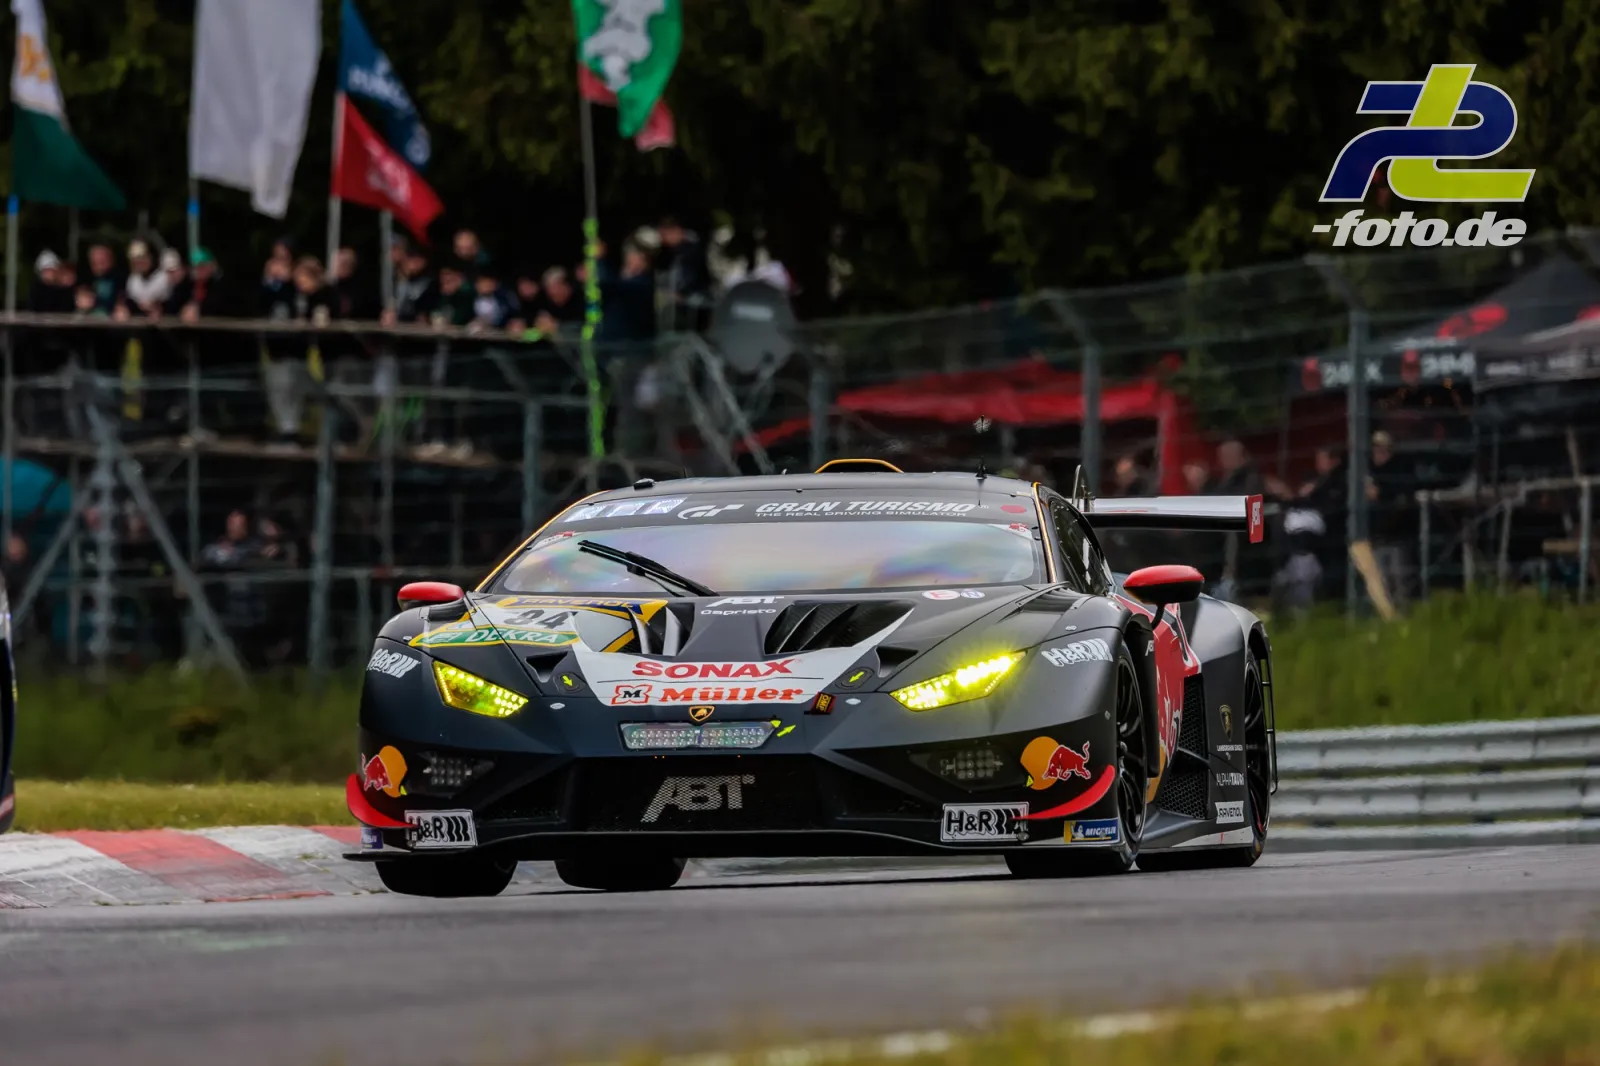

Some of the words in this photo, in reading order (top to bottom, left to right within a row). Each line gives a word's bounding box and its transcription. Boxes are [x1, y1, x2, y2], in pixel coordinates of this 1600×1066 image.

[756, 502, 841, 512] GRAN
[845, 501, 976, 512] TURISMO
[706, 596, 780, 607] ABT
[701, 608, 776, 616] Capristo
[467, 628, 559, 643] DEKRA
[367, 648, 405, 674] H&R
[1041, 642, 1095, 667] H&R
[632, 658, 796, 678] SONAX
[658, 686, 803, 702] Müller
[640, 776, 750, 822] ABT
[408, 815, 448, 842] H&R
[946, 809, 1000, 834] H&R
